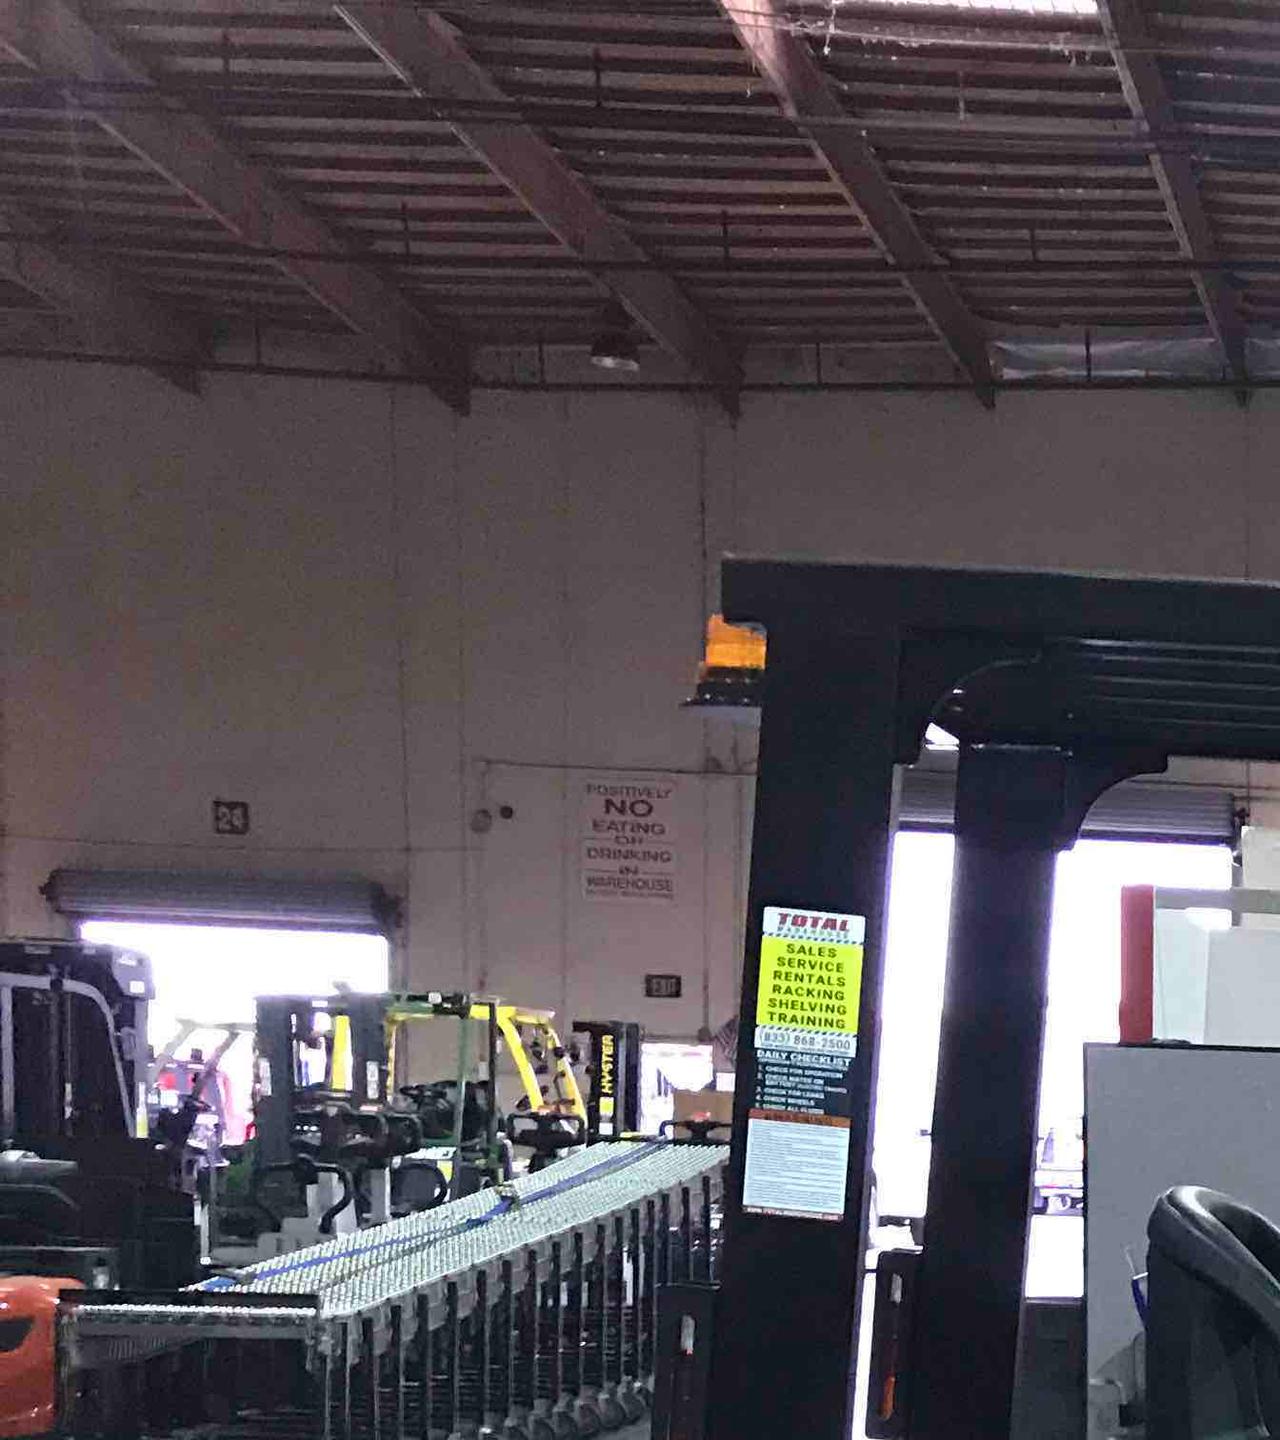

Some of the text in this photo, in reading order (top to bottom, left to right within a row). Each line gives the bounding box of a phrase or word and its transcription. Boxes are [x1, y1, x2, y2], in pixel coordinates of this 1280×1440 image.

[587, 783, 672, 799] POSITIVELY
[604, 798, 654, 817] NO
[592, 819, 666, 835] EATING
[587, 847, 672, 863] DRINKING
[586, 877, 673, 892] WAREHOUSE
[778, 913, 849, 932] TOTAL
[786, 943, 837, 958] SALES
[777, 957, 844, 973] SERVICE
[773, 970, 846, 987] RENTALS
[772, 984, 845, 1001] RACKING
[768, 998, 847, 1015] SHELVING
[767, 1011, 846, 1029] TRAINING
[602, 1034, 614, 1094] HYSTER
[757, 1049, 788, 1060] DAILY
[790, 1052, 851, 1067] CHECKLIST
